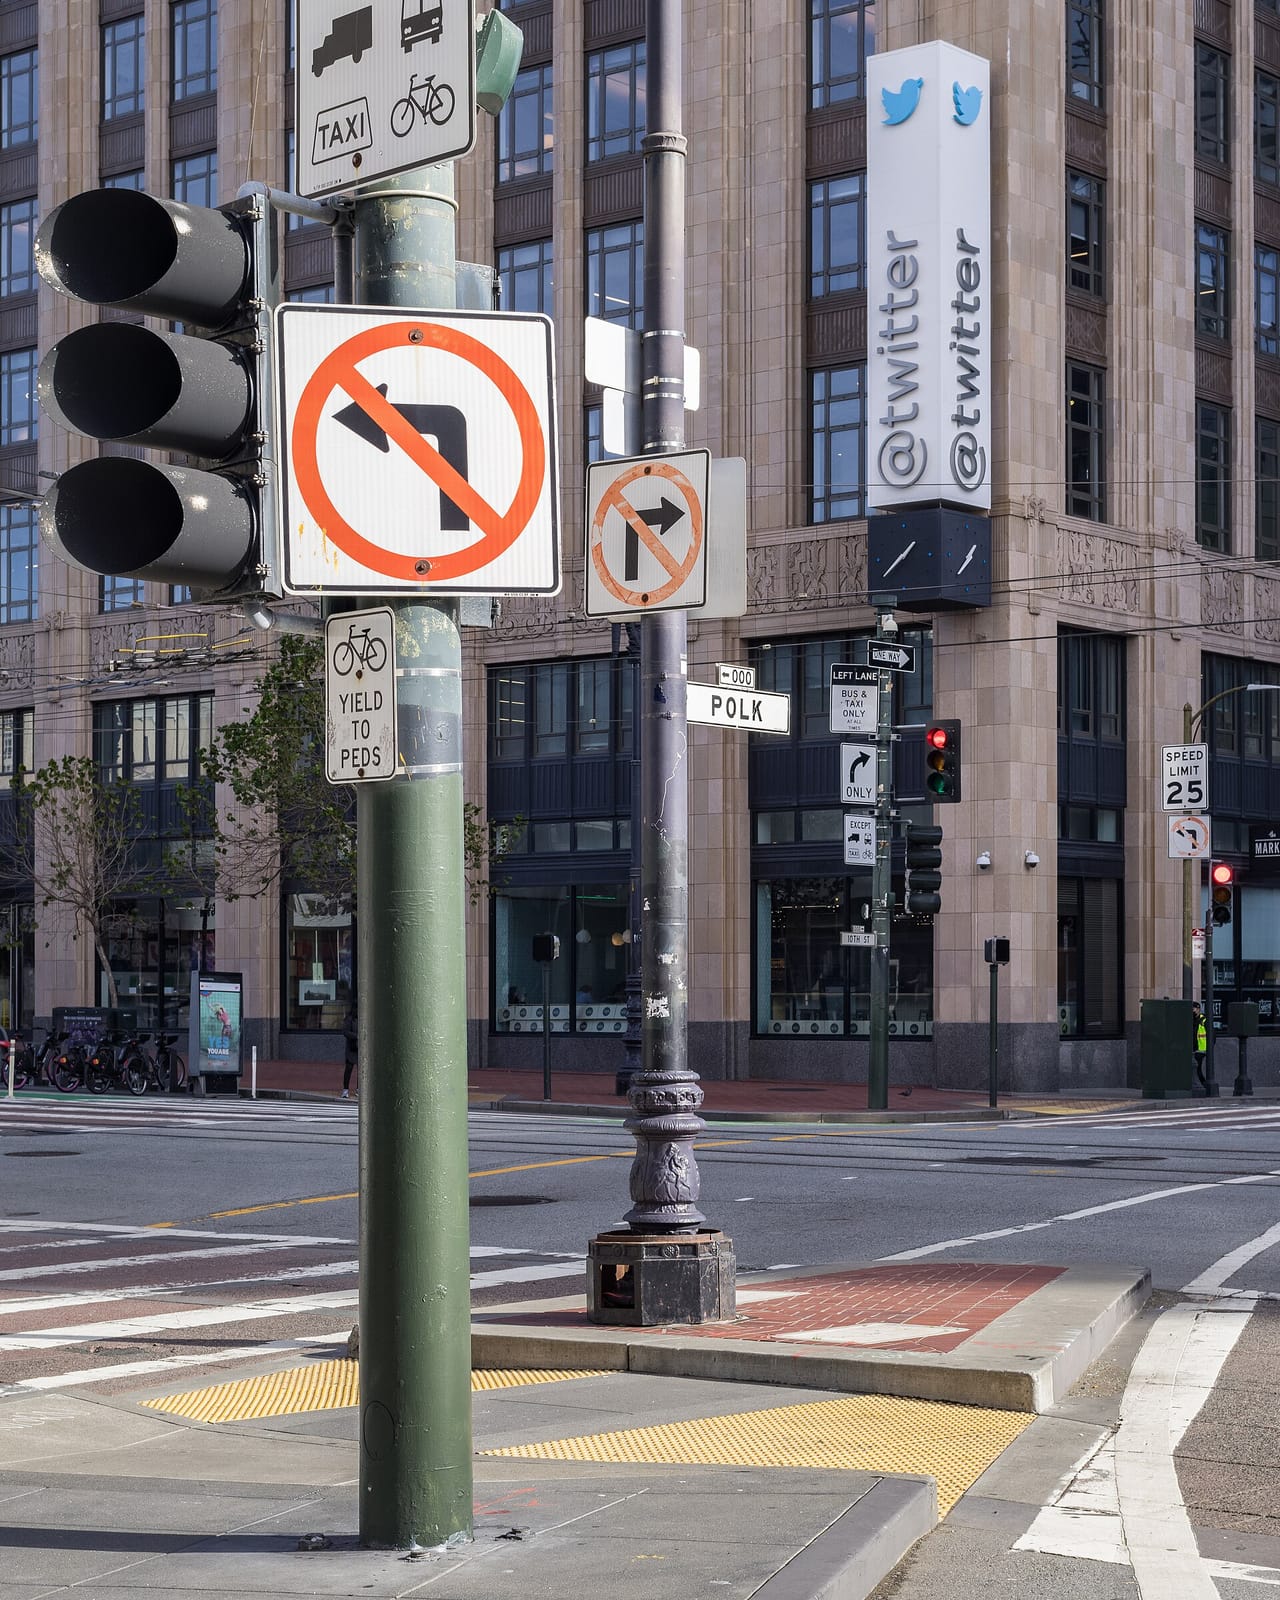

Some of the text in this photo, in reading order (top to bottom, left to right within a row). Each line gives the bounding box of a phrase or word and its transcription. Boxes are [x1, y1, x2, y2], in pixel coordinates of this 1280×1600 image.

[318, 112, 364, 149] TAXI
[877, 229, 928, 489] @twitter
[949, 227, 987, 492] @twitter
[873, 650, 900, 662] ONE WAY
[732, 669, 752, 685] 000
[833, 671, 878, 681] LEFT LANE
[841, 690, 868, 698] BUS &
[339, 690, 383, 714] YIELD
[711, 694, 763, 722] POLK
[845, 700, 864, 708] TAXI
[842, 709, 866, 718] ONLY
[352, 719, 370, 741] TO
[341, 746, 381, 769] PEDS
[1166, 750, 1204, 762] SPEED
[1169, 765, 1200, 777] LIMIT
[846, 786, 872, 798] ONLY
[1166, 780, 1203, 804] 25
[850, 820, 872, 830] EXCEPT
[847, 935, 870, 944] 10TH ST
[208, 1036, 230, 1049] YES
